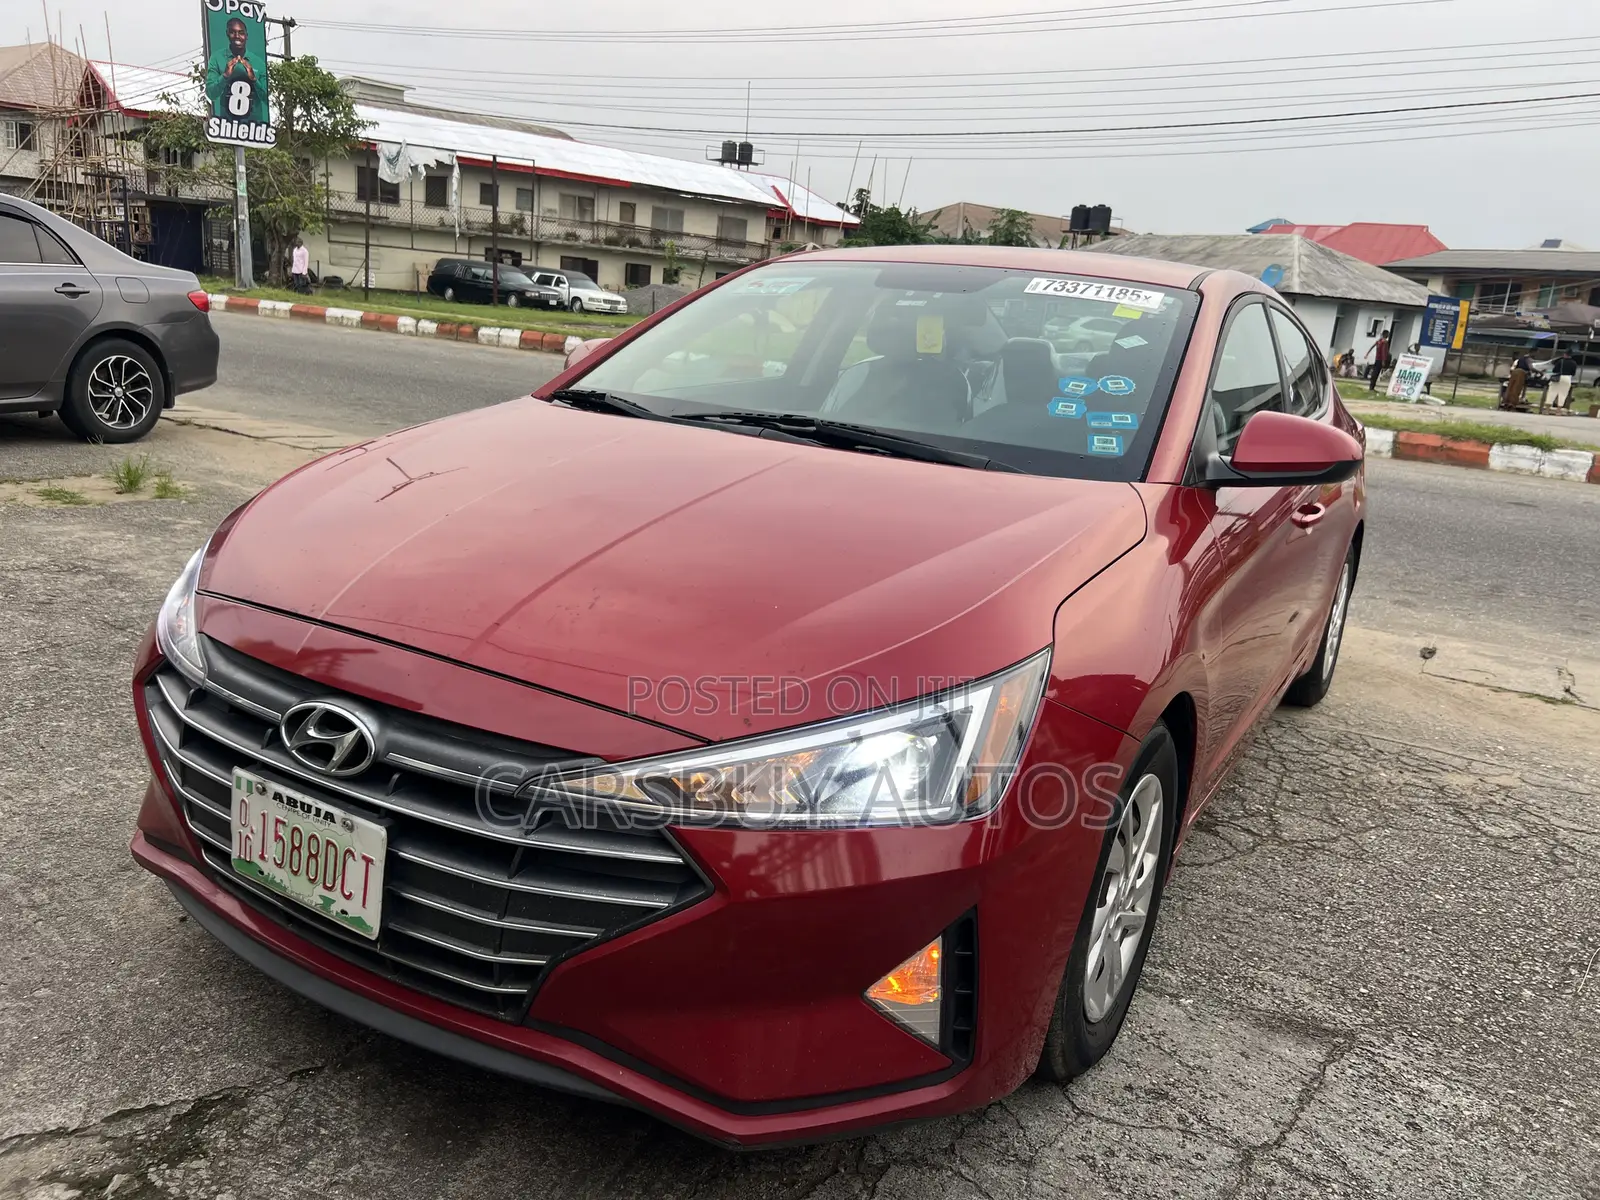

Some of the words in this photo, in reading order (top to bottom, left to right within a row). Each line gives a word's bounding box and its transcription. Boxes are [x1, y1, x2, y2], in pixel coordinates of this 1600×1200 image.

[228, 80, 251, 116] 8
[208, 117, 277, 143] Shields
[1397, 369, 1422, 383] JAMB
[272, 791, 336, 824] ABUJA
[276, 802, 301, 816] CENTRE
[301, 812, 311, 820] OF
[312, 817, 332, 828] UNITY
[259, 810, 375, 909] 1588DCT
